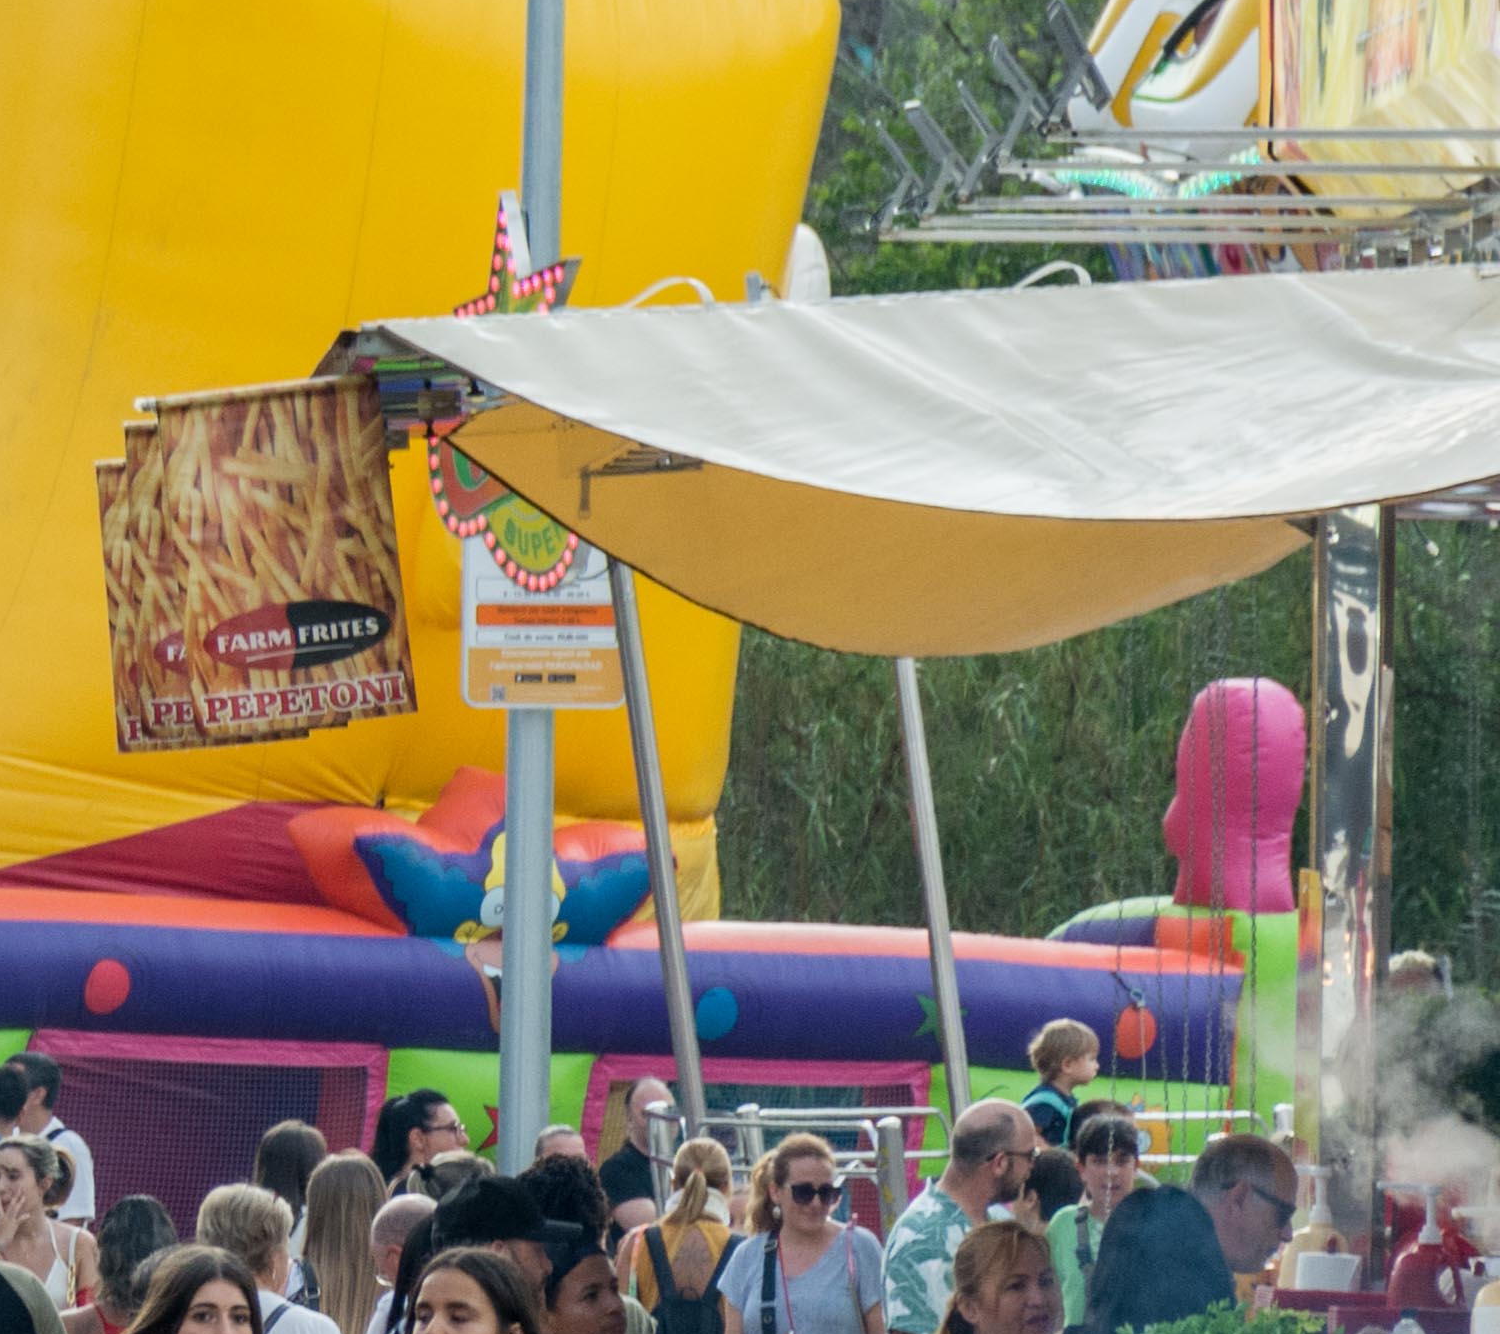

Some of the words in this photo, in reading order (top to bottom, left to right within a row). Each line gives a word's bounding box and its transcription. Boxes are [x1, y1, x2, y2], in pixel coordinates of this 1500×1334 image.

[215, 627, 292, 655] FARM
[297, 616, 381, 646] FRITES
[203, 673, 407, 726] PEPETONI
